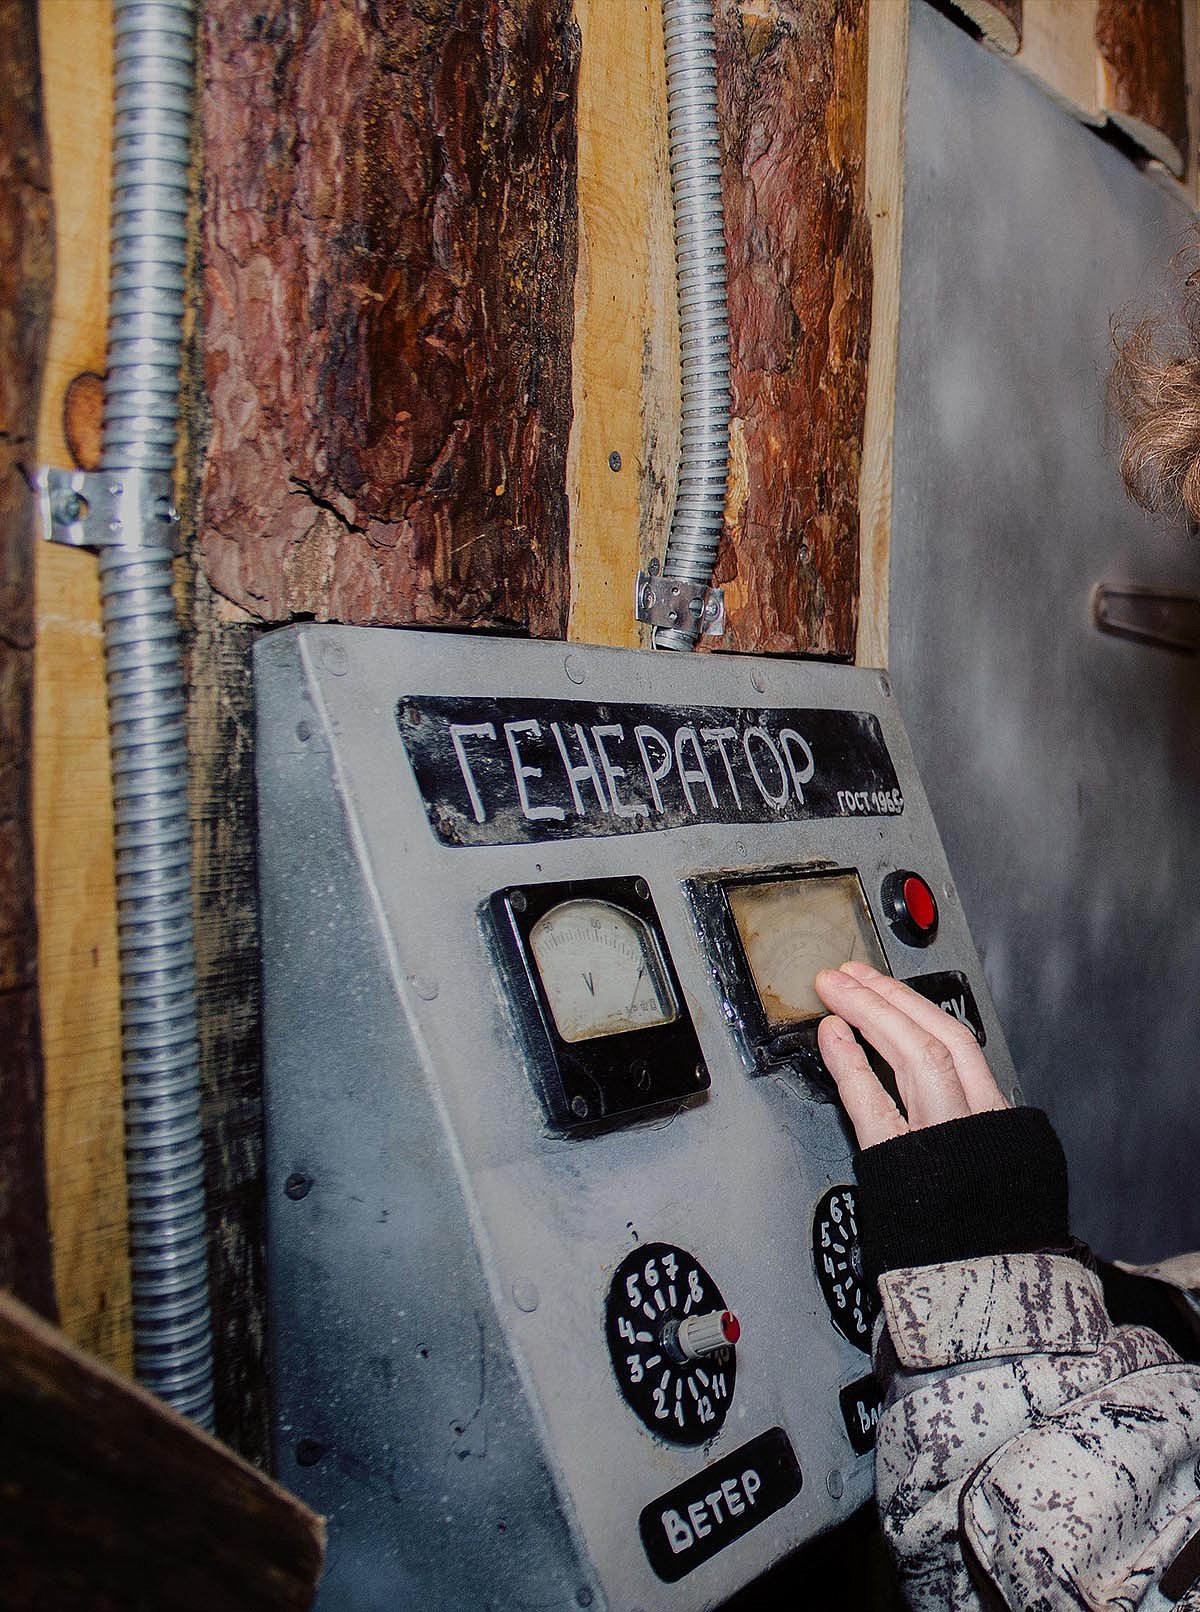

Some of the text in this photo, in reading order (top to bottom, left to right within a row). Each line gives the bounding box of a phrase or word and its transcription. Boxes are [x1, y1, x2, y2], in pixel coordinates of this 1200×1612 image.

[450, 719, 814, 823] ГЕНЕРАТОР
[836, 790, 871, 814] ГОСТ
[581, 971, 595, 997] V
[829, 1196, 843, 1223] 6
[821, 1221, 831, 1248] 5
[644, 1258, 660, 1287] 6
[661, 1253, 679, 1281] 7
[823, 1253, 836, 1279] 4
[626, 1273, 642, 1307] 5
[688, 1269, 704, 1303] 8
[833, 1284, 847, 1309] 3
[618, 1316, 636, 1345] 4
[853, 1307, 867, 1334] 2
[626, 1354, 644, 1383] 3
[712, 1372, 727, 1399] 11
[652, 1387, 670, 1419] 2
[673, 1400, 685, 1427] 1
[697, 1395, 716, 1424] 12
[661, 1468, 761, 1554] ВЕТЕР
